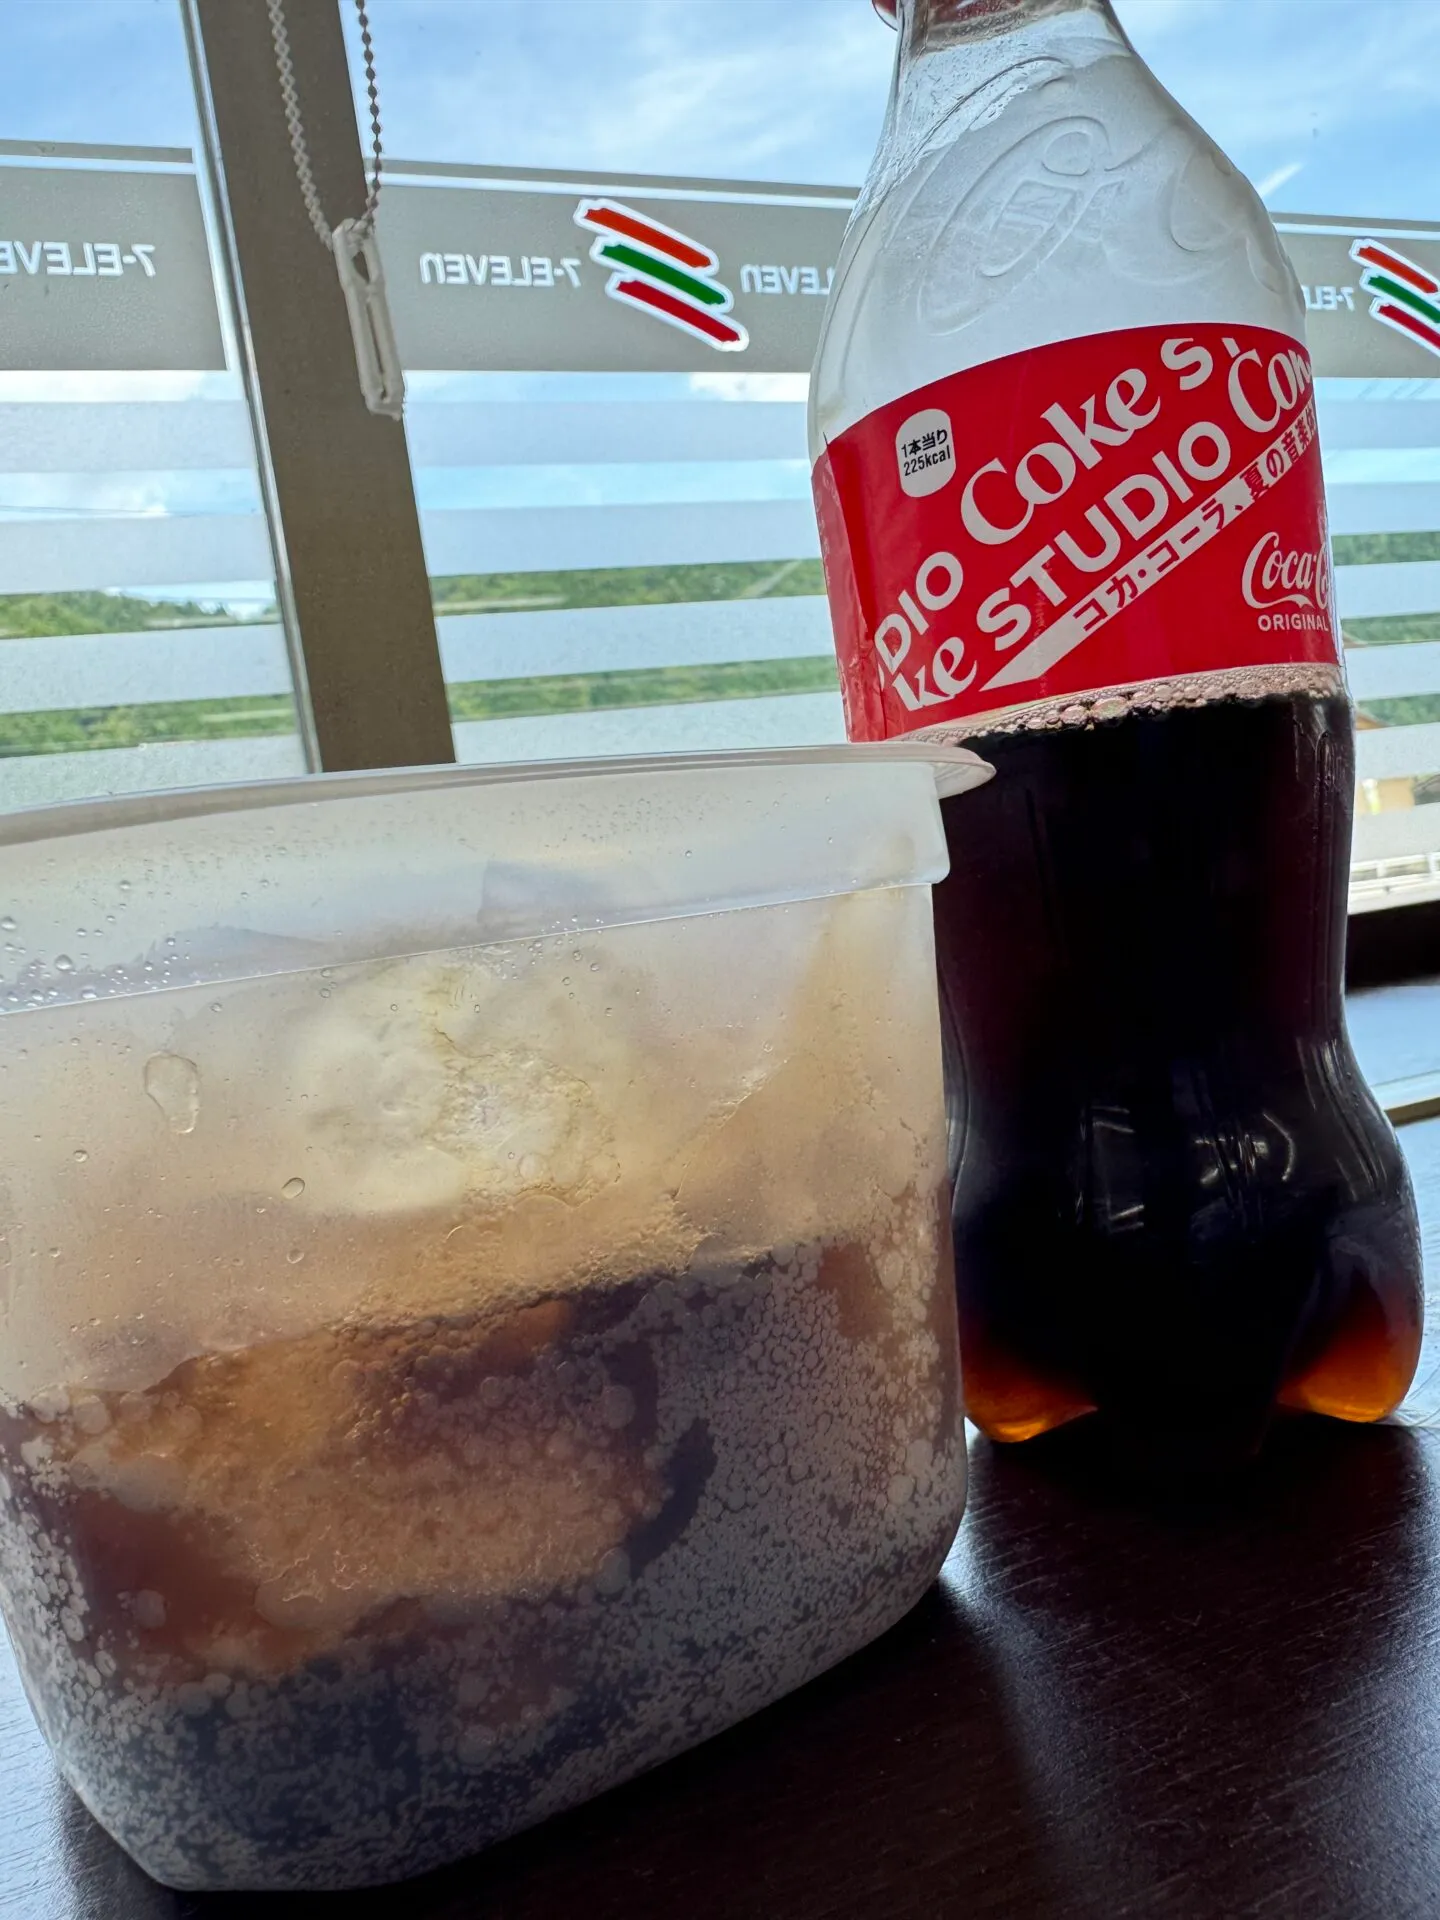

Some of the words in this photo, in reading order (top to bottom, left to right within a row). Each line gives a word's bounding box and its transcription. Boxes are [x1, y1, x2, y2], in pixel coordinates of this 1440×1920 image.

[901, 428, 948, 458] 1本当り
[960, 368, 1161, 545] Coke
[903, 444, 951, 476] 225kcal
[976, 421, 1231, 651] STUDIO
[1257, 613, 1329, 632] ORIGINAL
